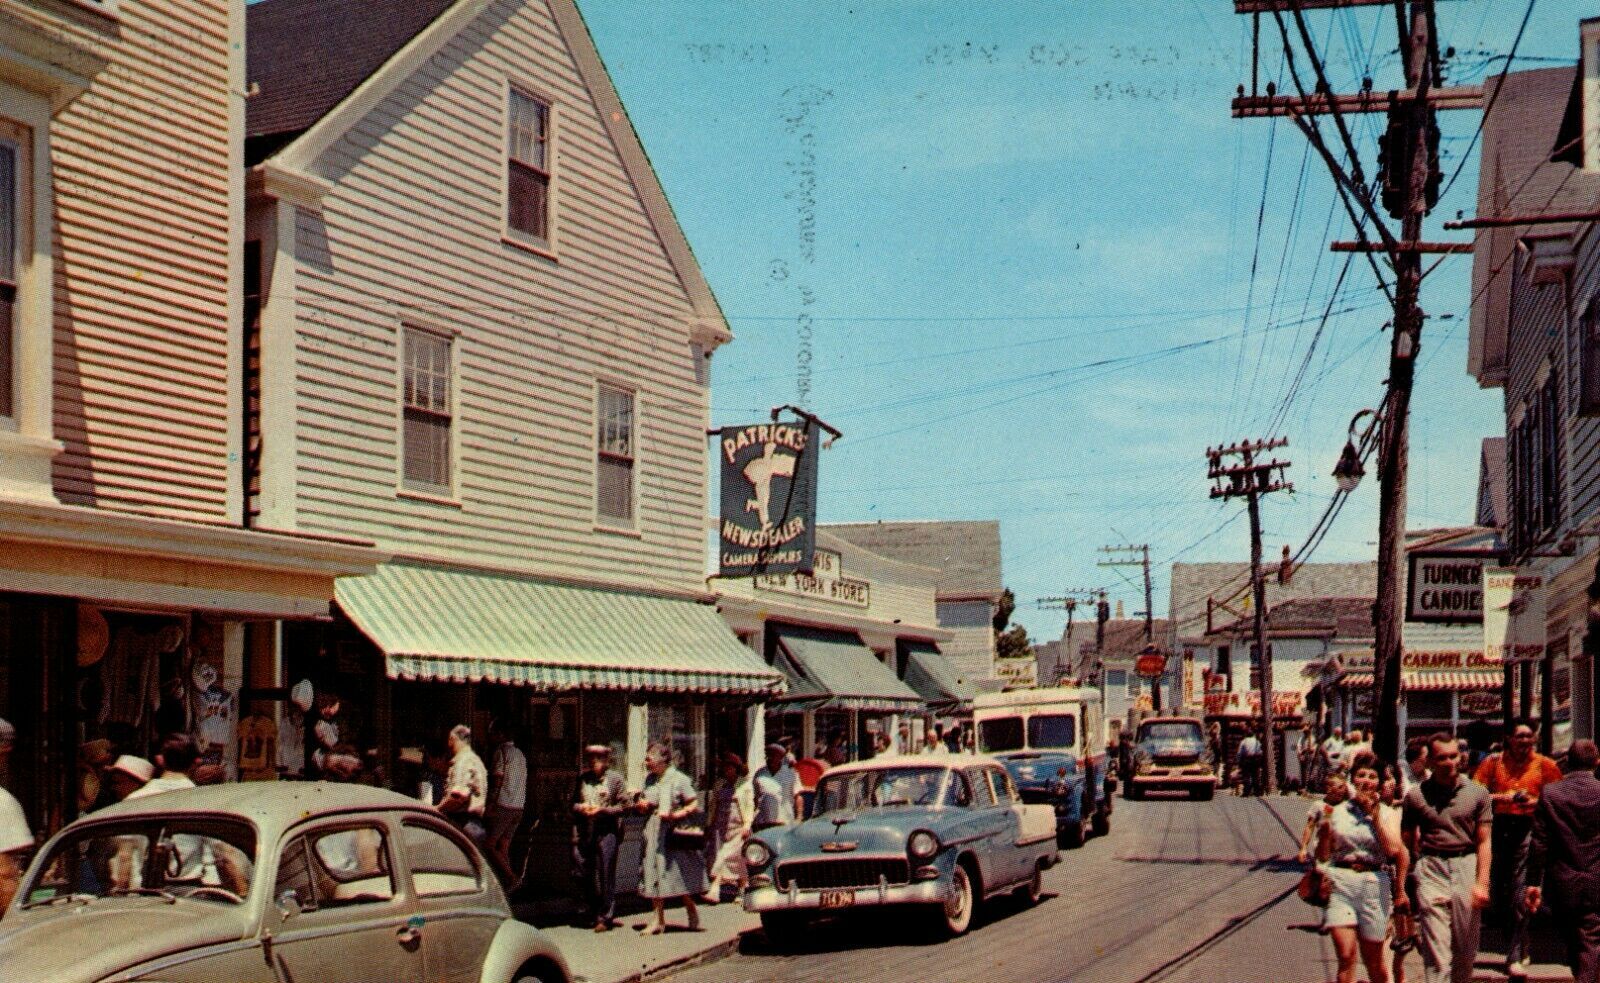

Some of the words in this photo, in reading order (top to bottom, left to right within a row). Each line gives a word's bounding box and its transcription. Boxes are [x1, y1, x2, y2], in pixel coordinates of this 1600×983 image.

[723, 516, 806, 548] NEWSDEALER
[794, 574, 825, 595] YORK
[831, 581, 865, 603] STORE
[1421, 589, 1483, 611] CANDIE
[1402, 650, 1463, 668] CARAMEL
